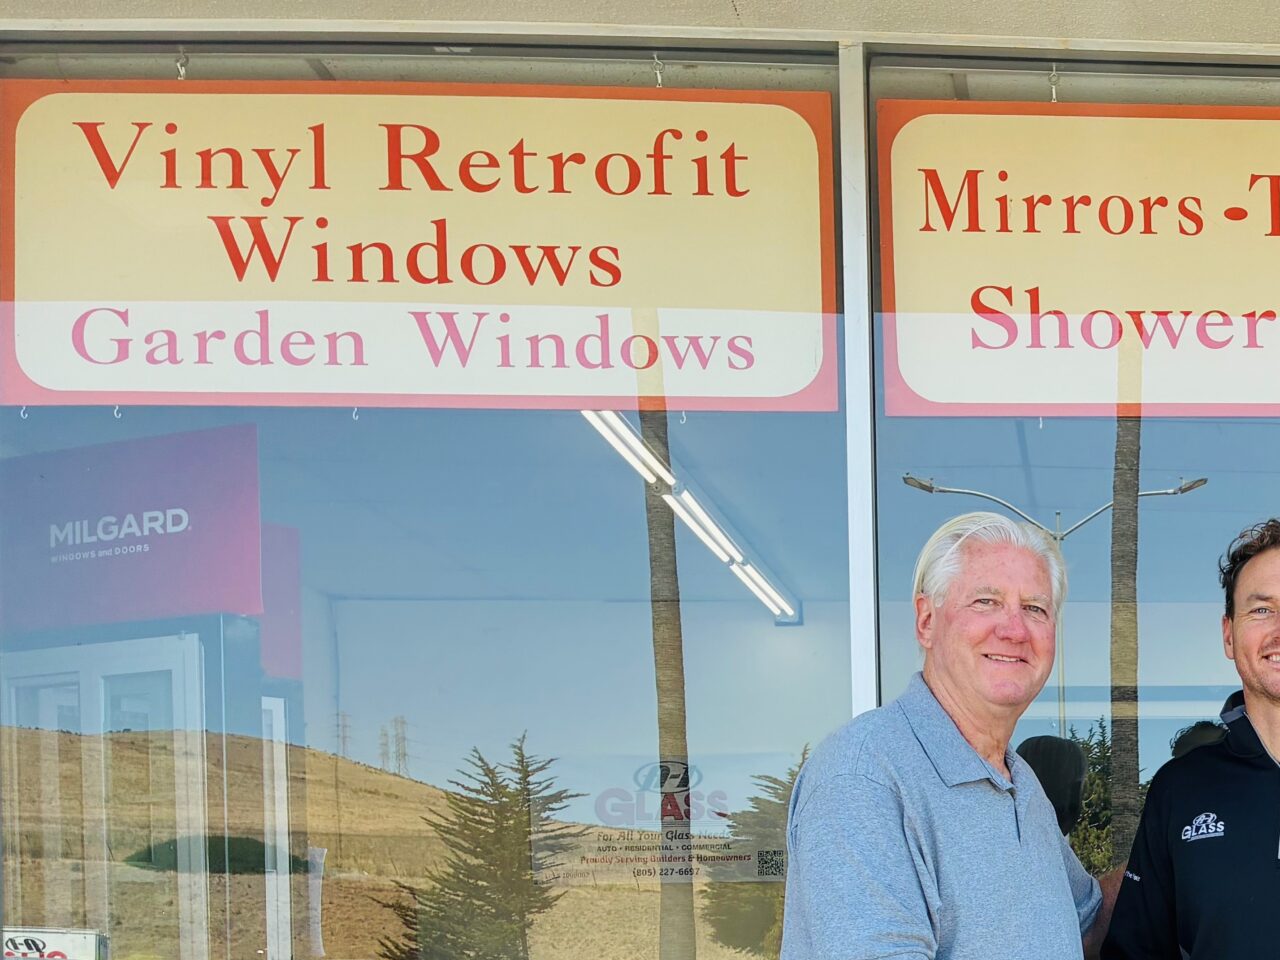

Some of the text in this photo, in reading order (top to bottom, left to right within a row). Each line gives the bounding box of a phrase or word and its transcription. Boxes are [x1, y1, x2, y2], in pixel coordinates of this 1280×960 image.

[72, 121, 750, 206] Vinyl Retrofit
[917, 168, 1204, 237] Mirrors
[207, 215, 623, 288] Windows
[71, 308, 757, 372] Garden Windows
[970, 286, 1277, 351] Shower
[114, 543, 150, 556] DOORS
[595, 787, 729, 826] GLASS
[1181, 821, 1225, 840] GLASS
[650, 854, 685, 863] Builders
[696, 853, 752, 862] Homeowners
[665, 830, 694, 842] Glass
